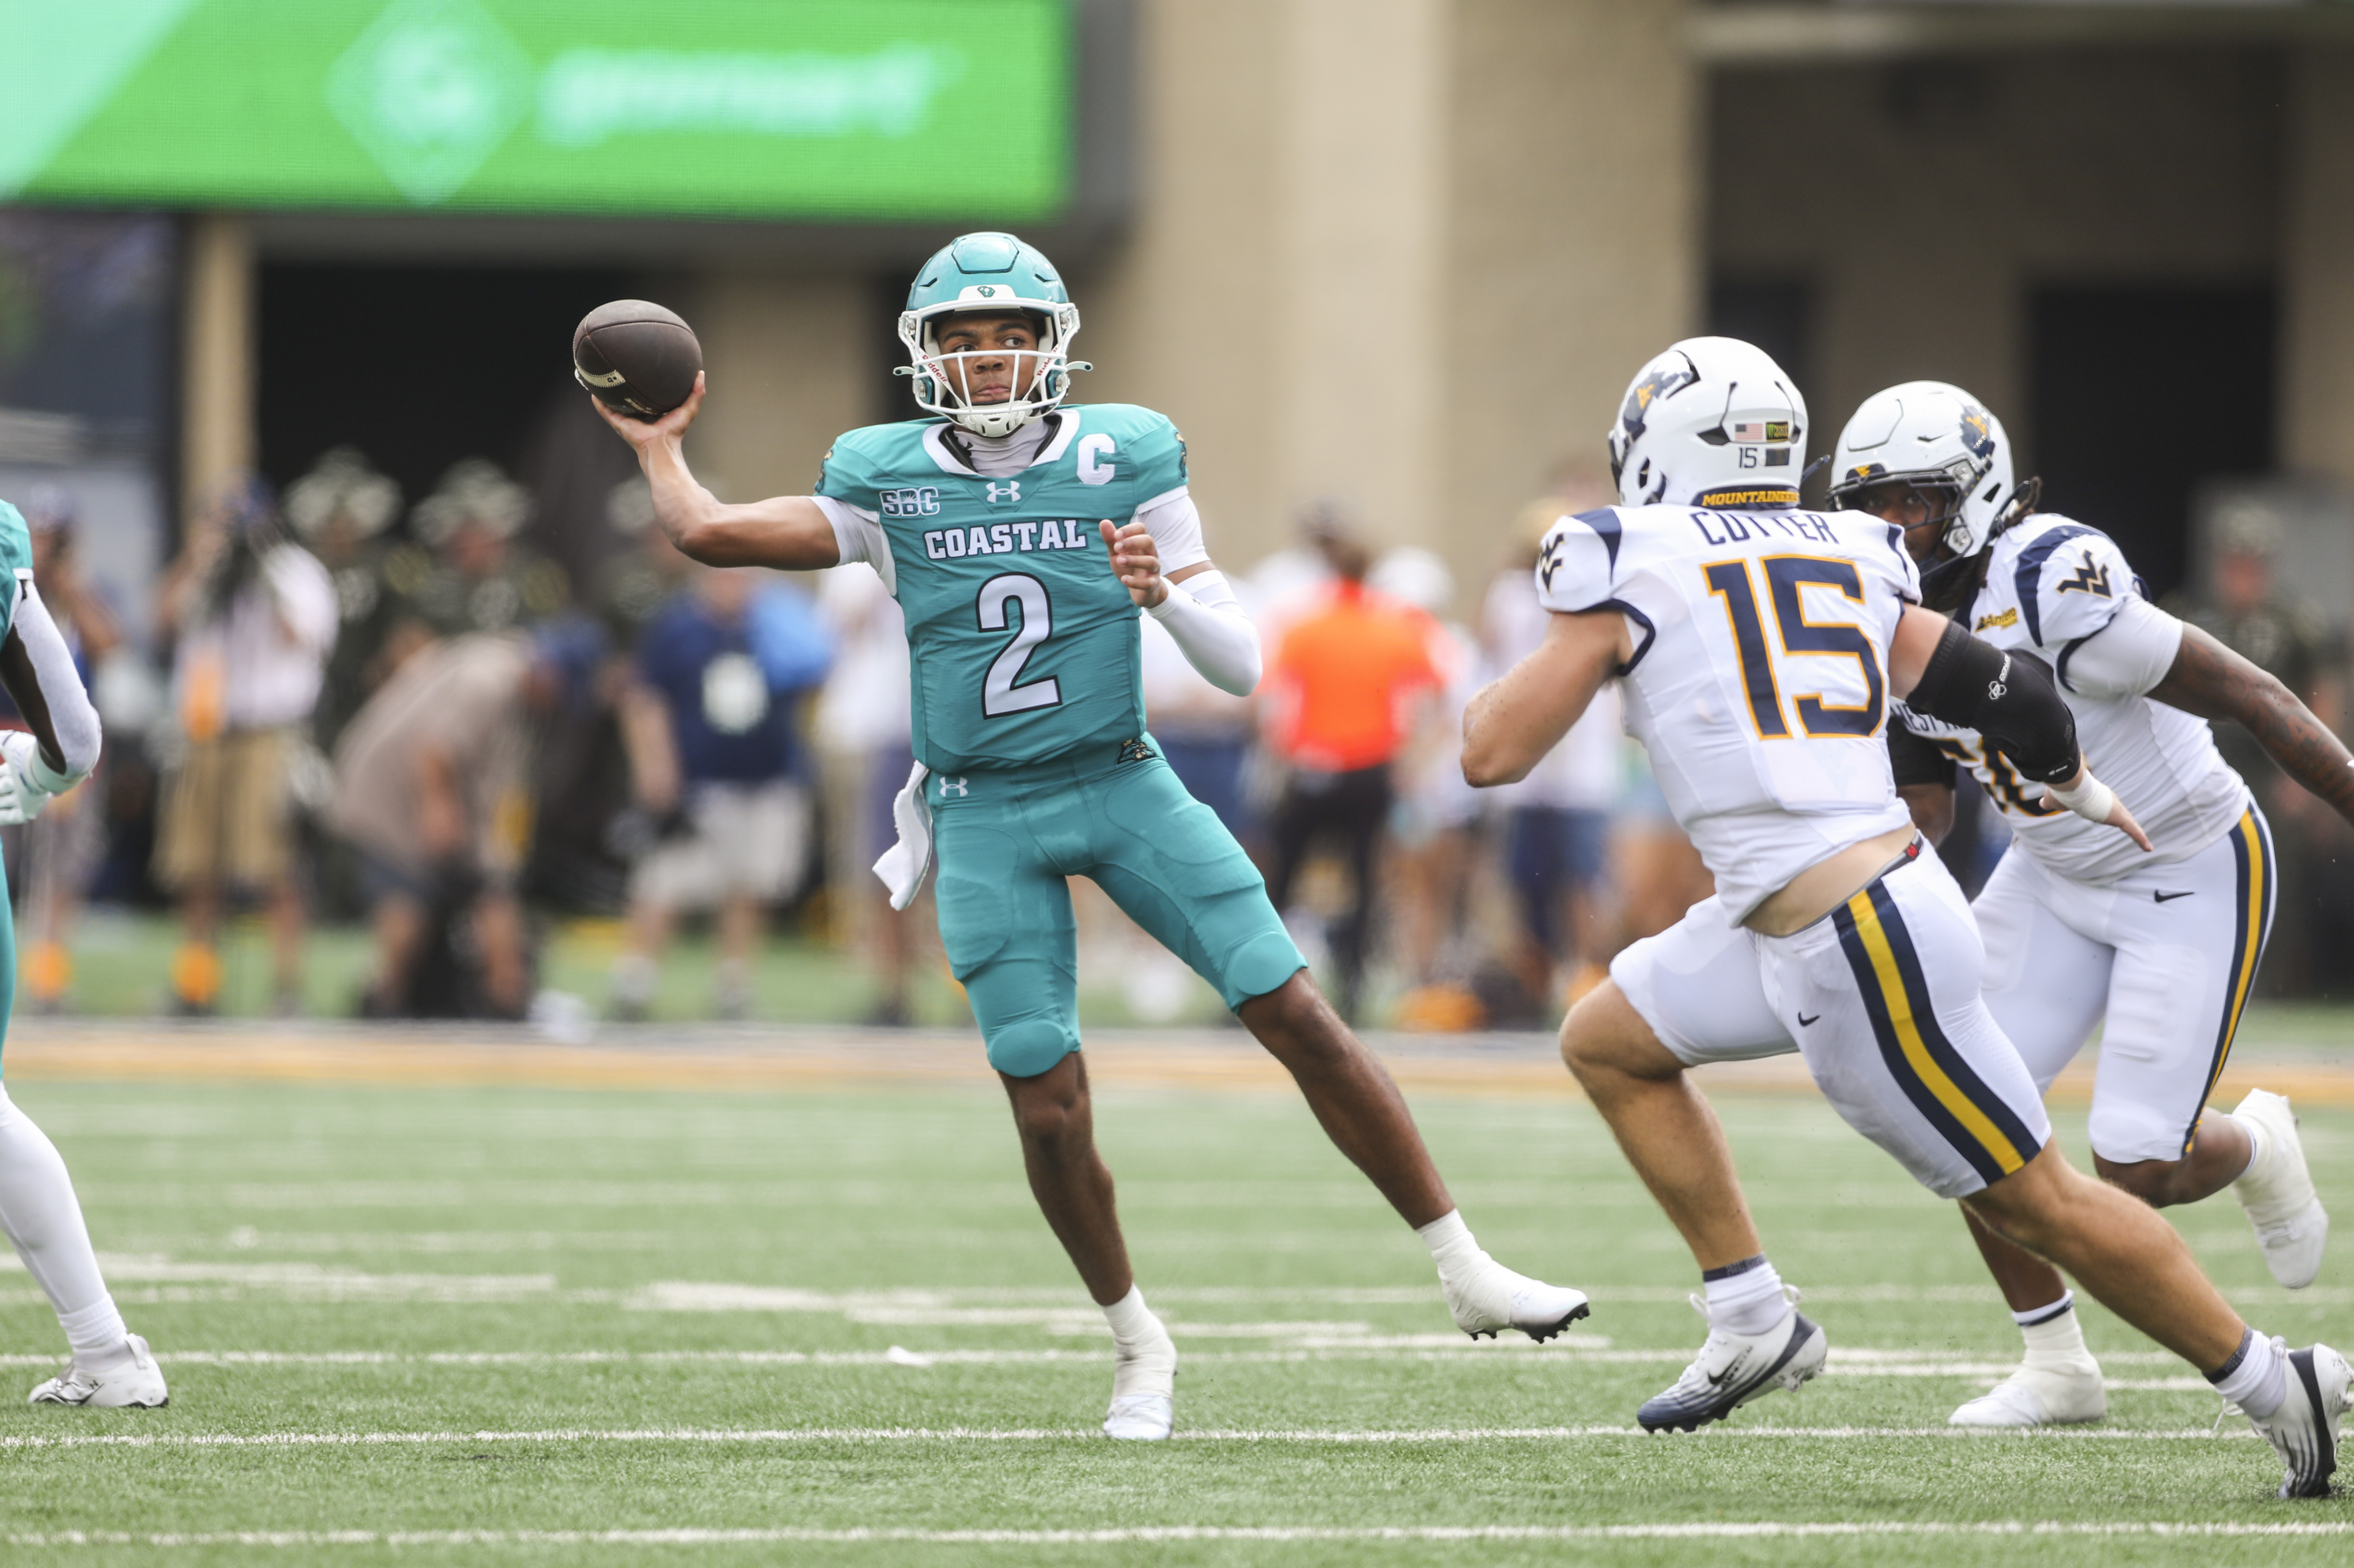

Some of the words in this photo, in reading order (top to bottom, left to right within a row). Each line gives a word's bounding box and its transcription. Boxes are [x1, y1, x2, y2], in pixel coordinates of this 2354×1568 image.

[922, 354, 947, 382] Rddell
[1077, 433, 1116, 485] C
[1739, 447, 1758, 468] 15
[879, 486, 940, 517] SBC
[925, 519, 1086, 559] COASTAL
[1690, 511, 1840, 544] CUTTER
[975, 571, 1063, 720] 2
[1699, 553, 1884, 741] 15
